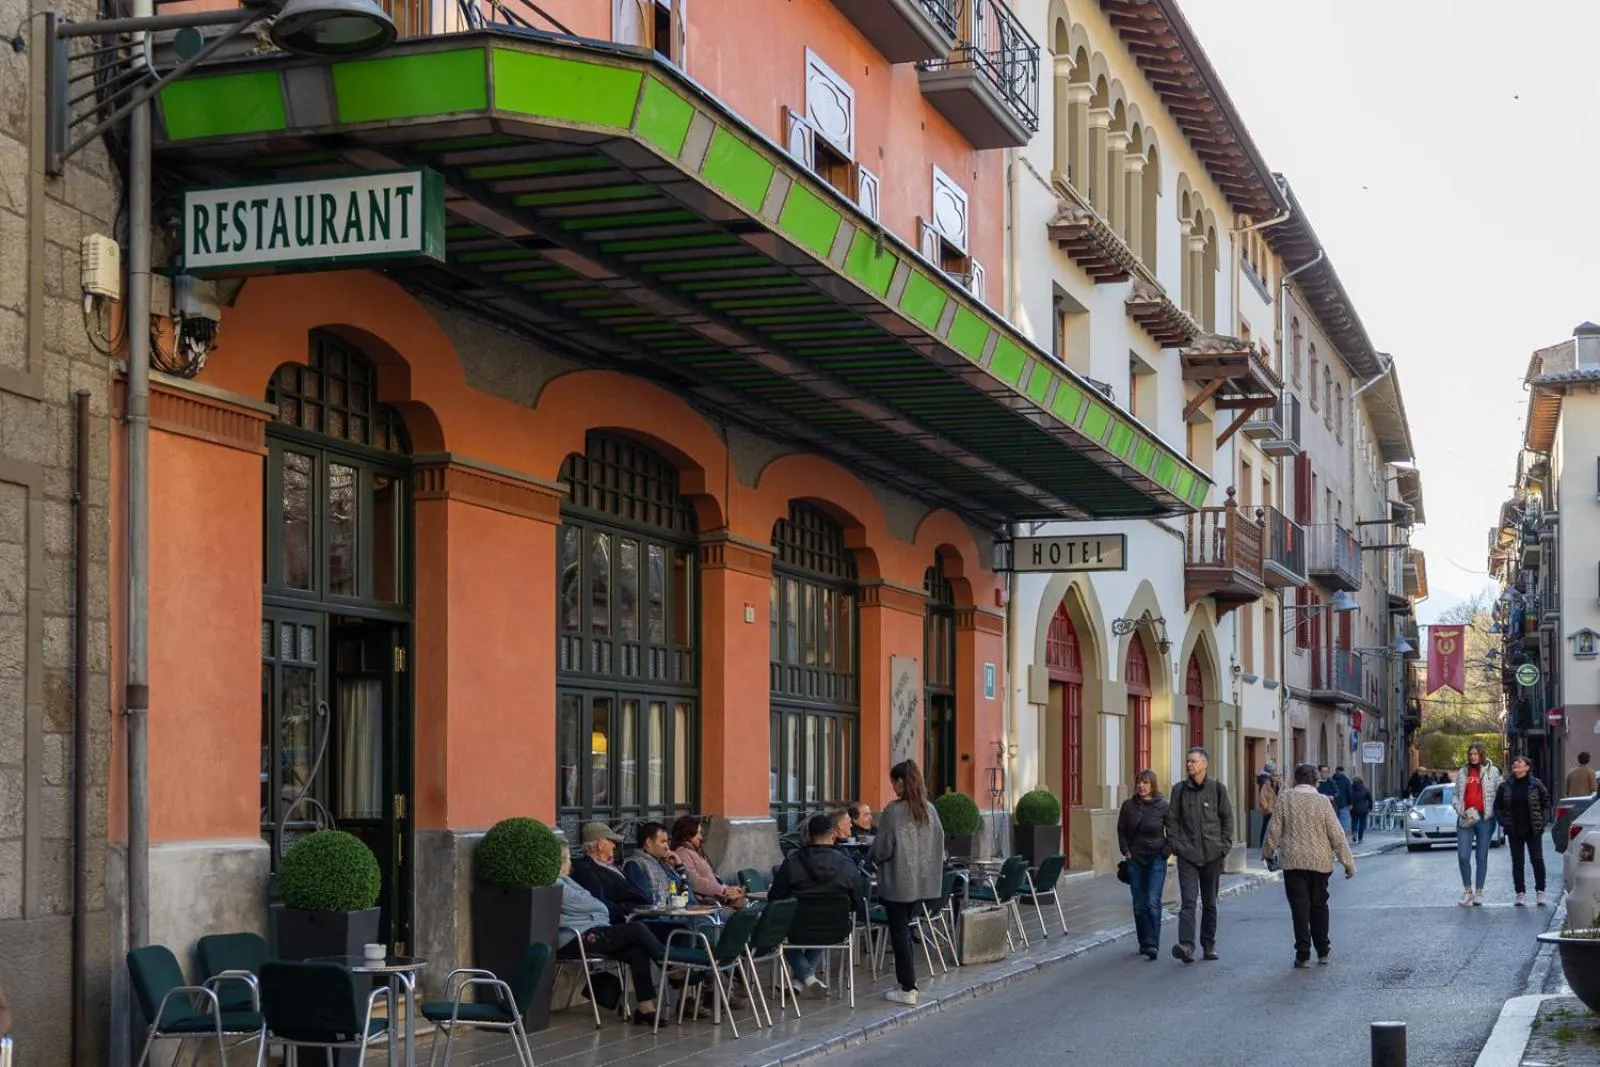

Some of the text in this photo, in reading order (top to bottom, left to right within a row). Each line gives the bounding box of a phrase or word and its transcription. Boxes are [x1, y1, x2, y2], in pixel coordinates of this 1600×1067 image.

[192, 185, 414, 255] RESTAURANT
[1032, 541, 1103, 565] HOTEL
[987, 668, 993, 687] H
